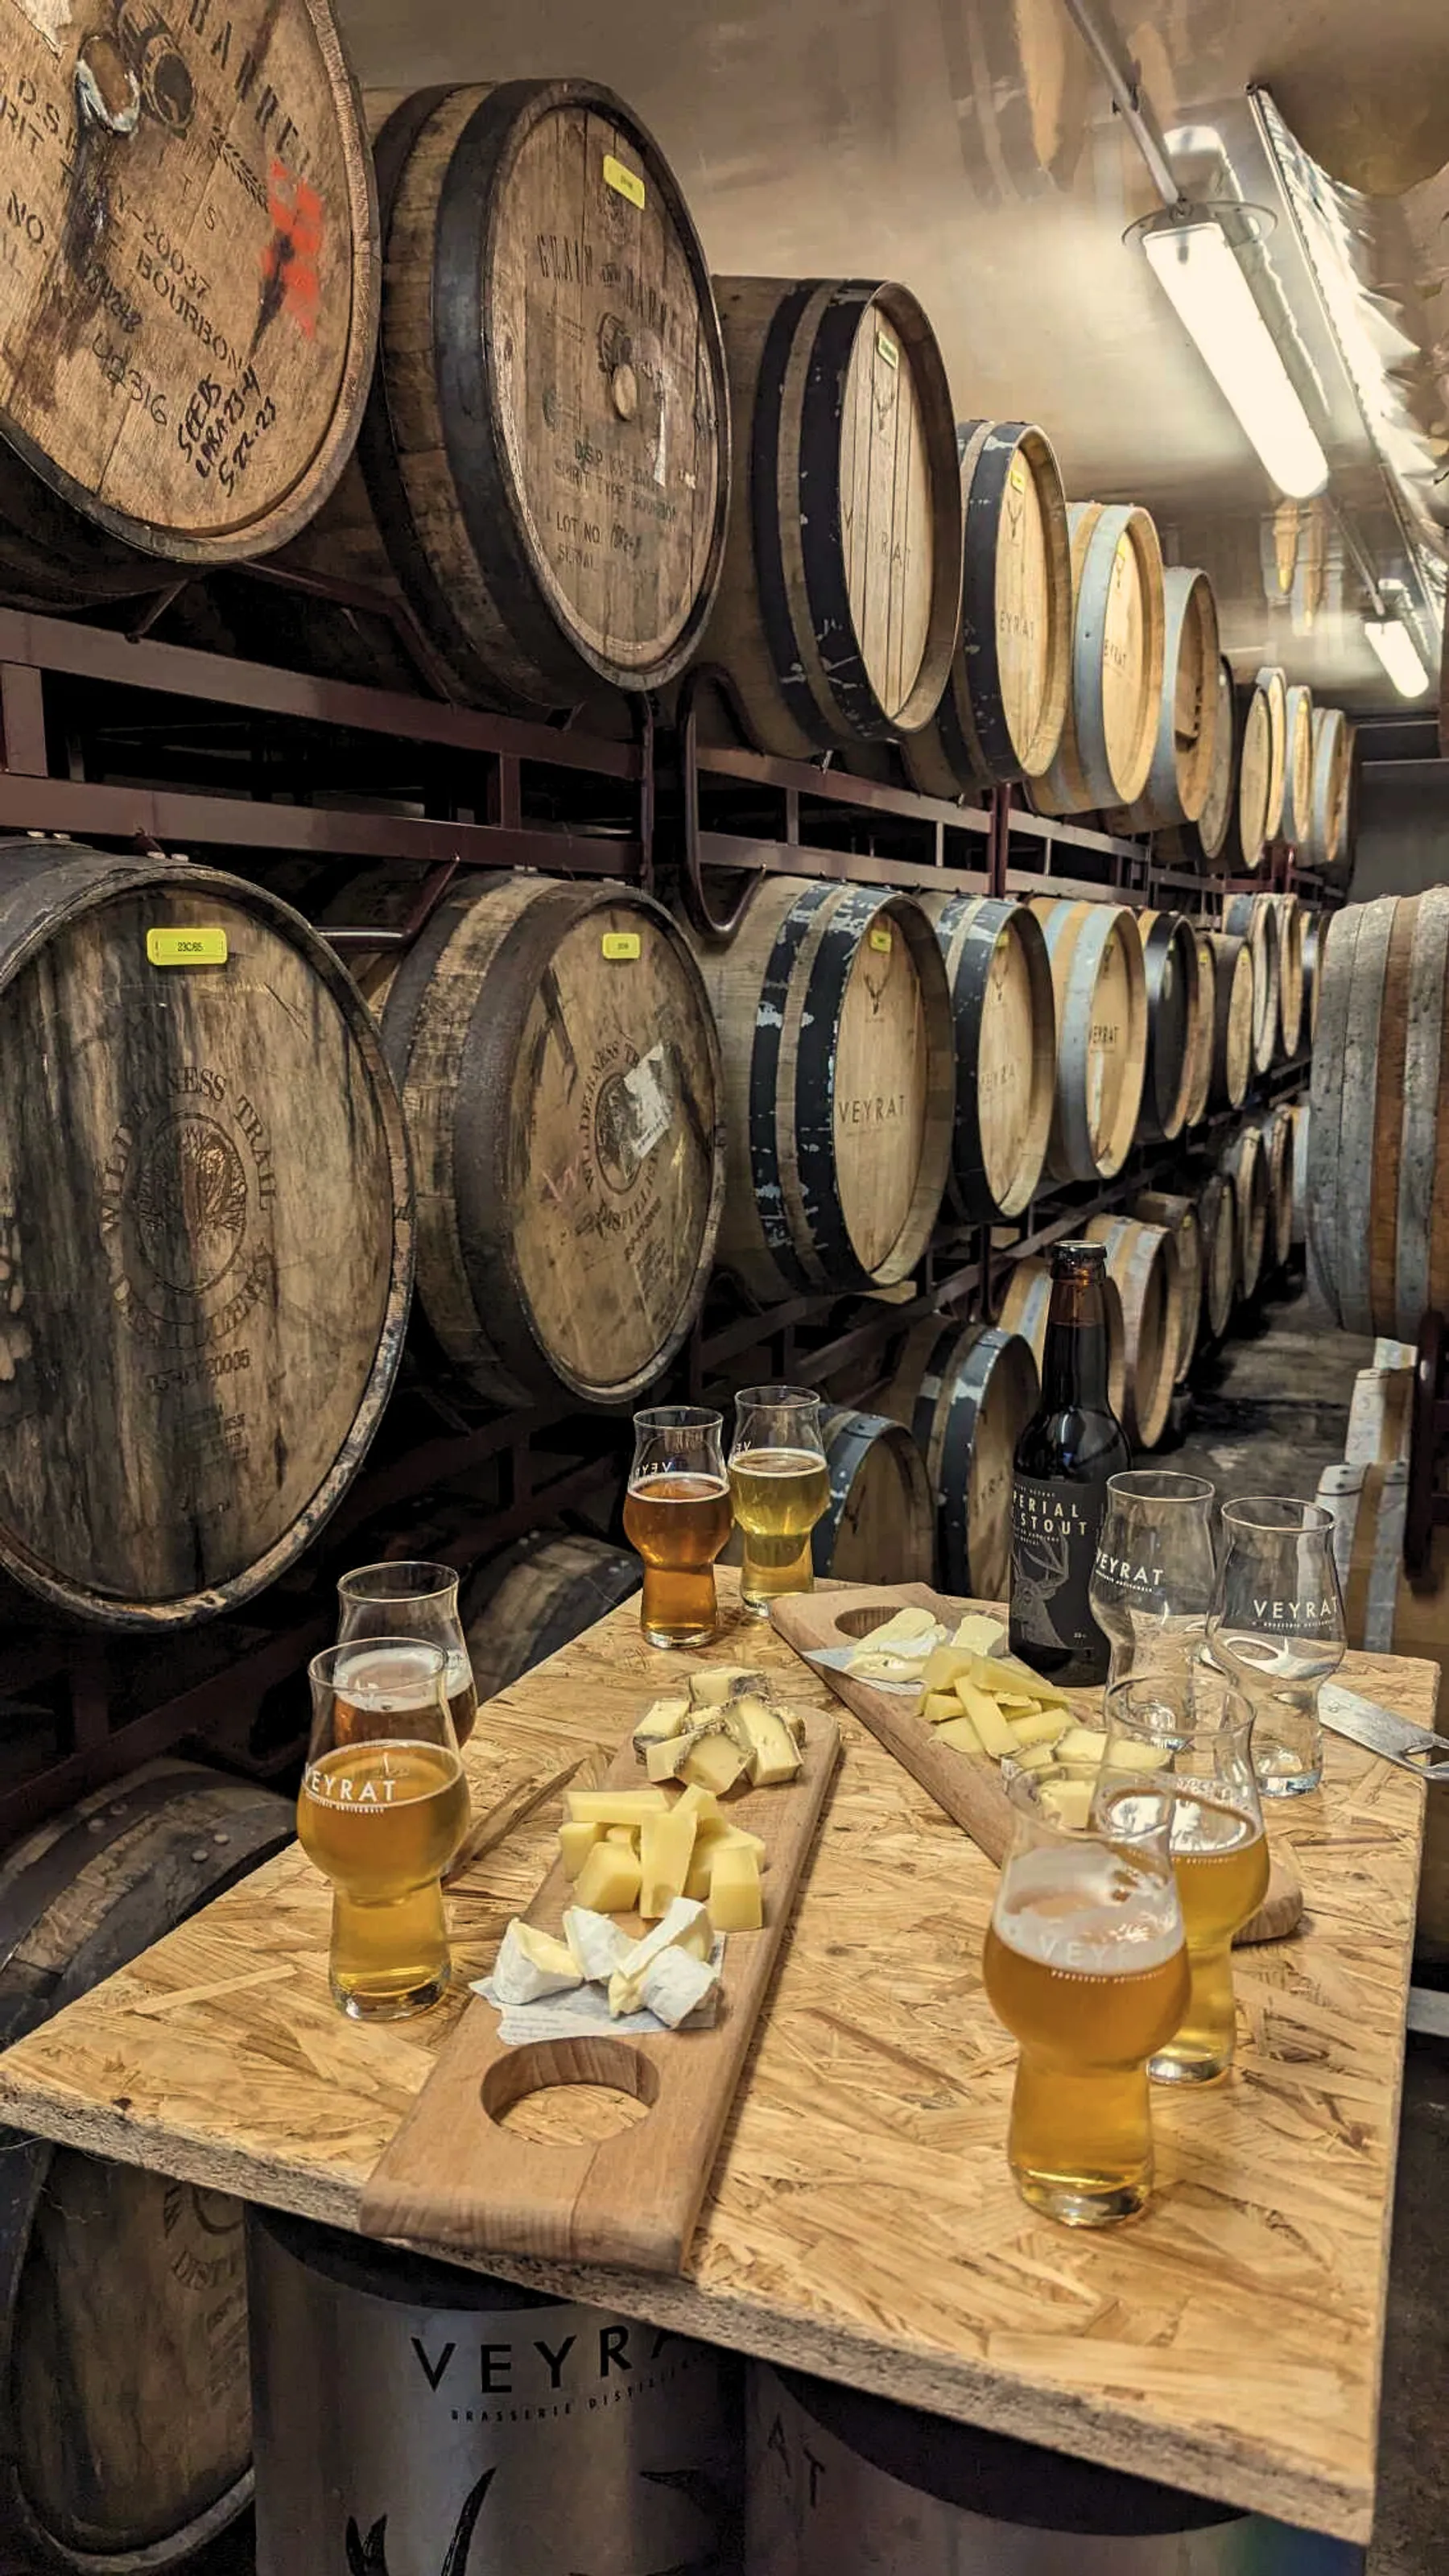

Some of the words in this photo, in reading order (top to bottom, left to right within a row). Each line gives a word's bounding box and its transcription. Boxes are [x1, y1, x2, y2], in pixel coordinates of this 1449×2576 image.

[135, 249, 245, 378] BOURBON
[838, 1095, 906, 1125] VEYRAT
[233, 1092, 278, 1212] TRAIL
[1020, 1511, 1088, 1537] STOUT
